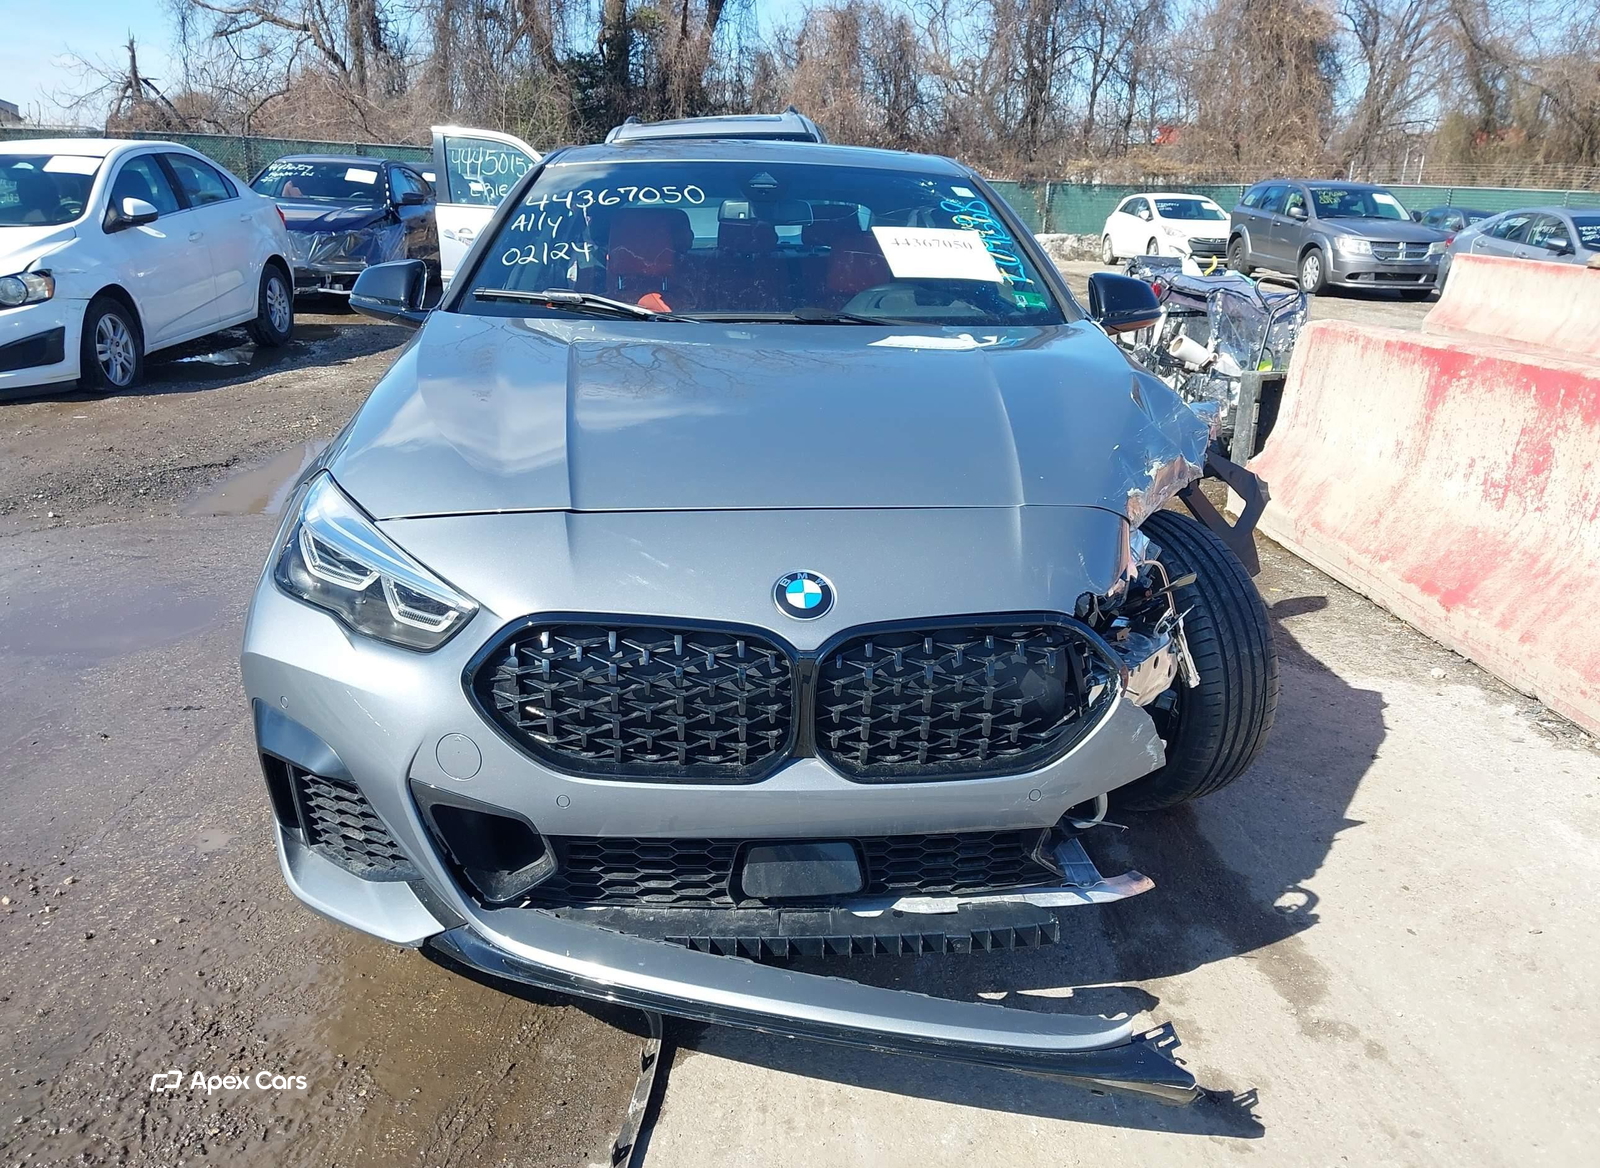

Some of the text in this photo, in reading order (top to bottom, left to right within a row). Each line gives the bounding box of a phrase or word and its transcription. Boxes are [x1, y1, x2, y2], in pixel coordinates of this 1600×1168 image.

[451, 147, 534, 178] 4445015
[526, 185, 706, 211] 44367050
[511, 212, 563, 238] Ally
[779, 573, 826, 587] BMW
